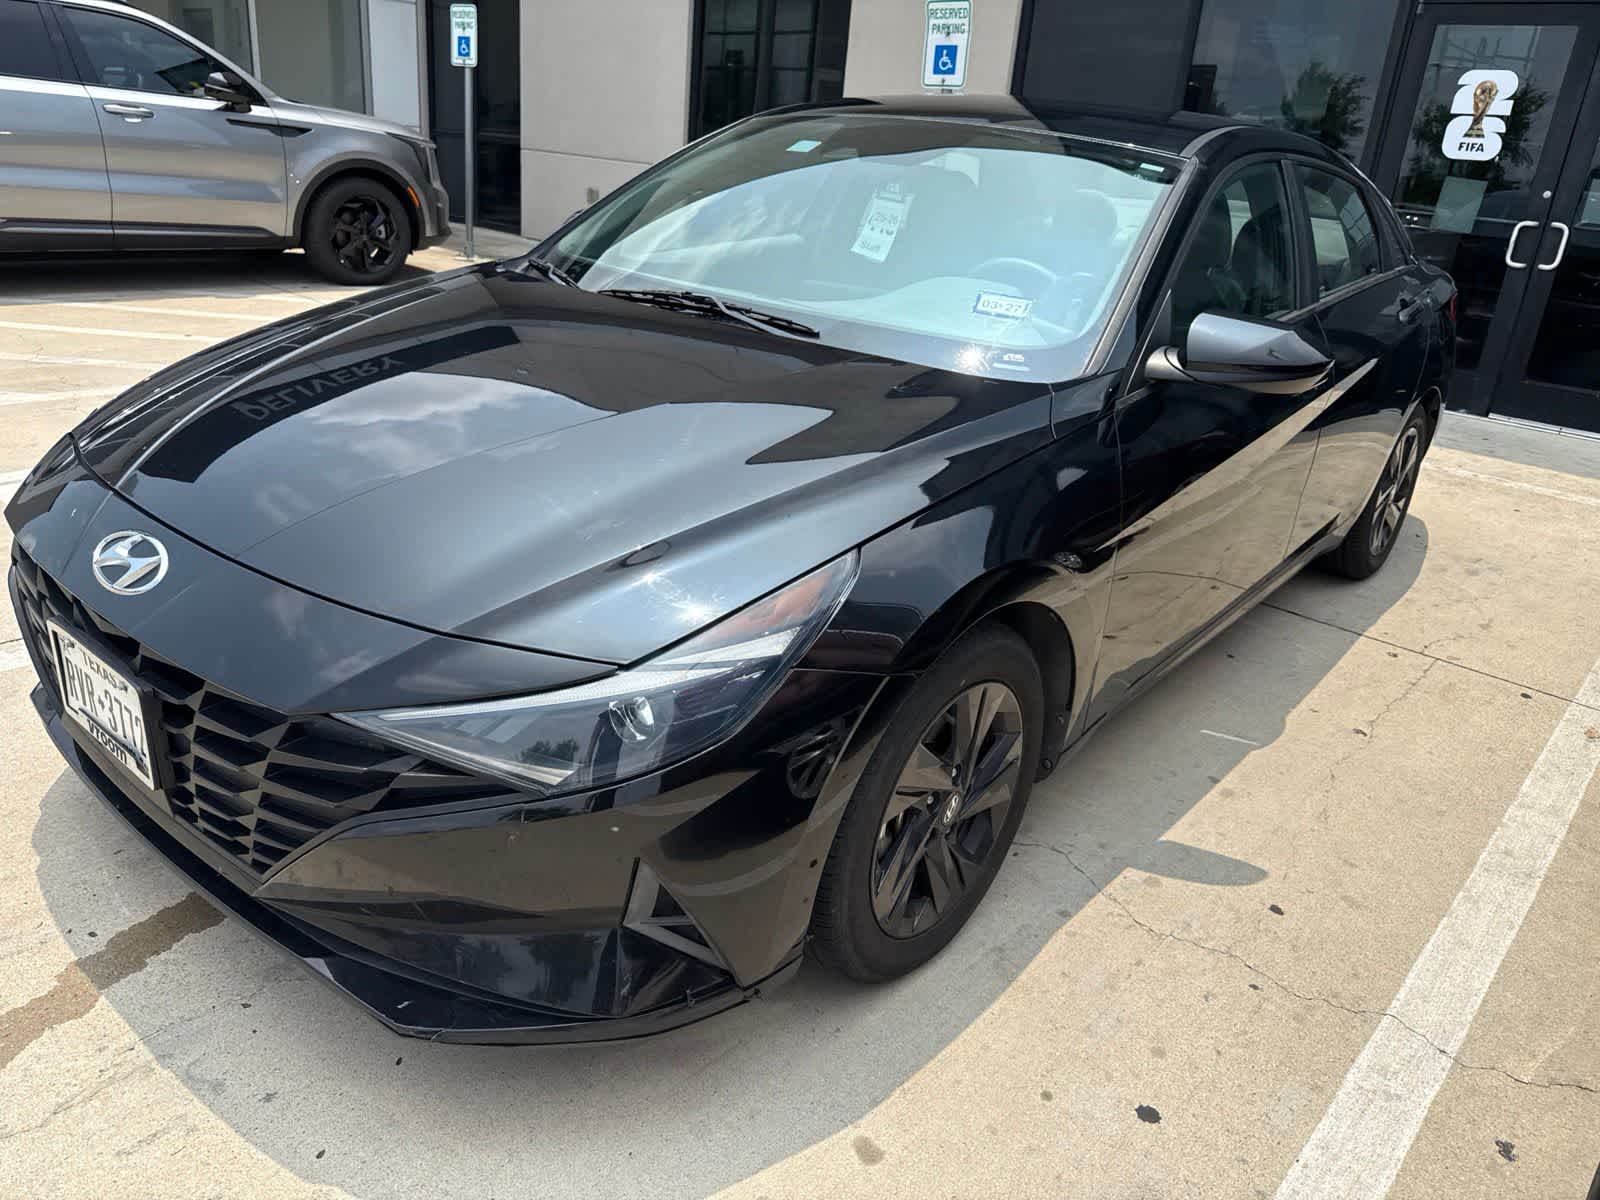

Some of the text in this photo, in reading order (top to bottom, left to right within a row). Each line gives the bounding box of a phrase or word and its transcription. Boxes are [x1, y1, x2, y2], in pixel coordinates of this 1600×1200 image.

[929, 8, 968, 19] RESERVED
[932, 23, 966, 34] PARKING
[1458, 142, 1485, 153] FIFA
[81, 648, 118, 689] TEXAS
